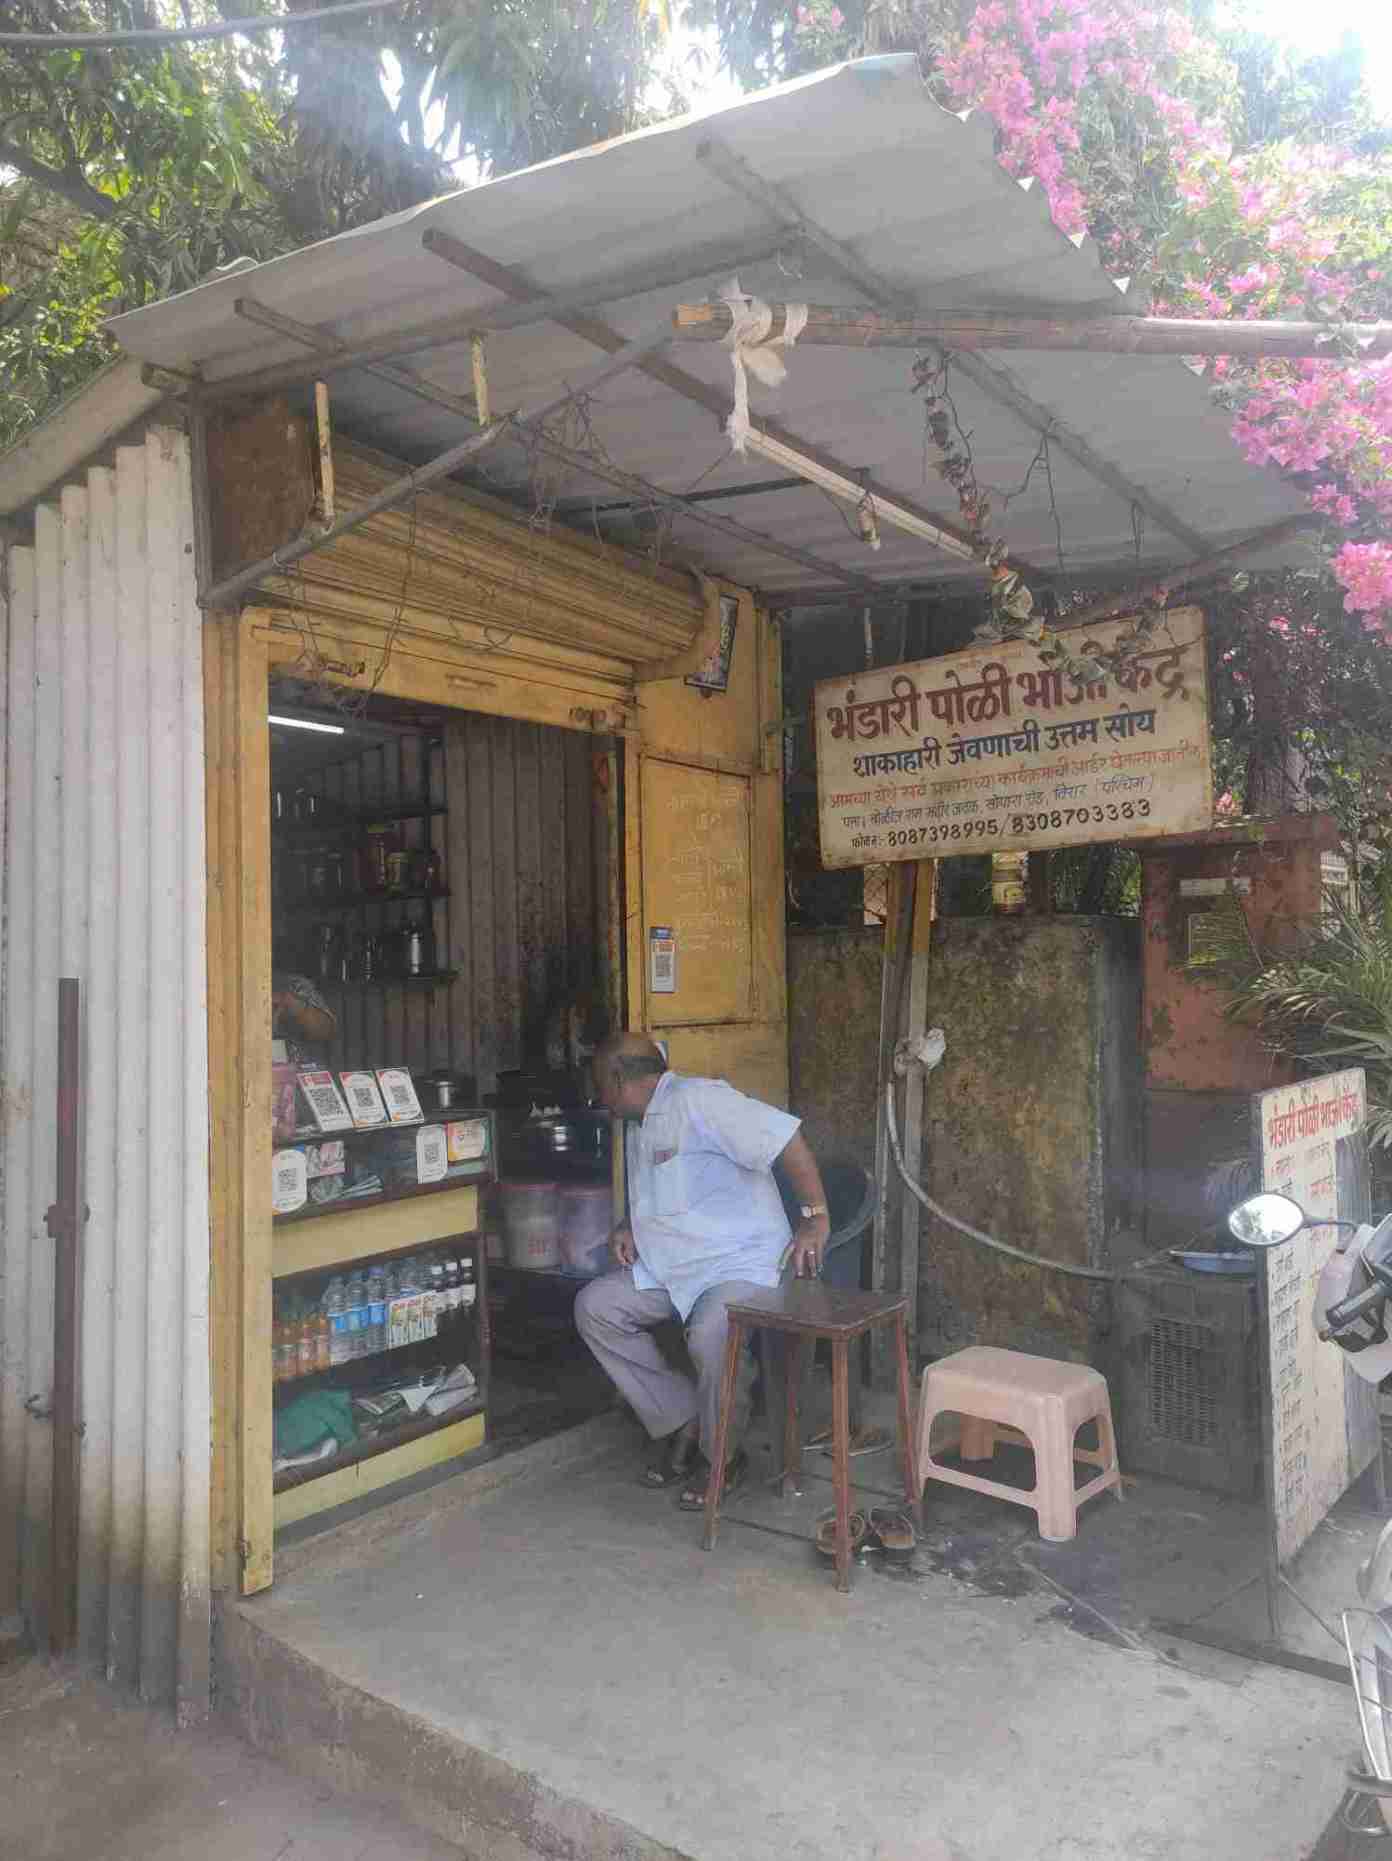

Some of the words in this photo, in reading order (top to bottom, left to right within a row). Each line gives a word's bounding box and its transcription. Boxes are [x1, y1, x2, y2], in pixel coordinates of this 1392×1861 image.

[827, 675, 921, 740] भंडारी
[926, 662, 1011, 726] पोळी
[854, 736, 942, 777] शाकाहारी
[946, 719, 1040, 765] जेवणाची
[1044, 717, 1101, 751] उत्तम
[1103, 702, 1157, 743] सोय
